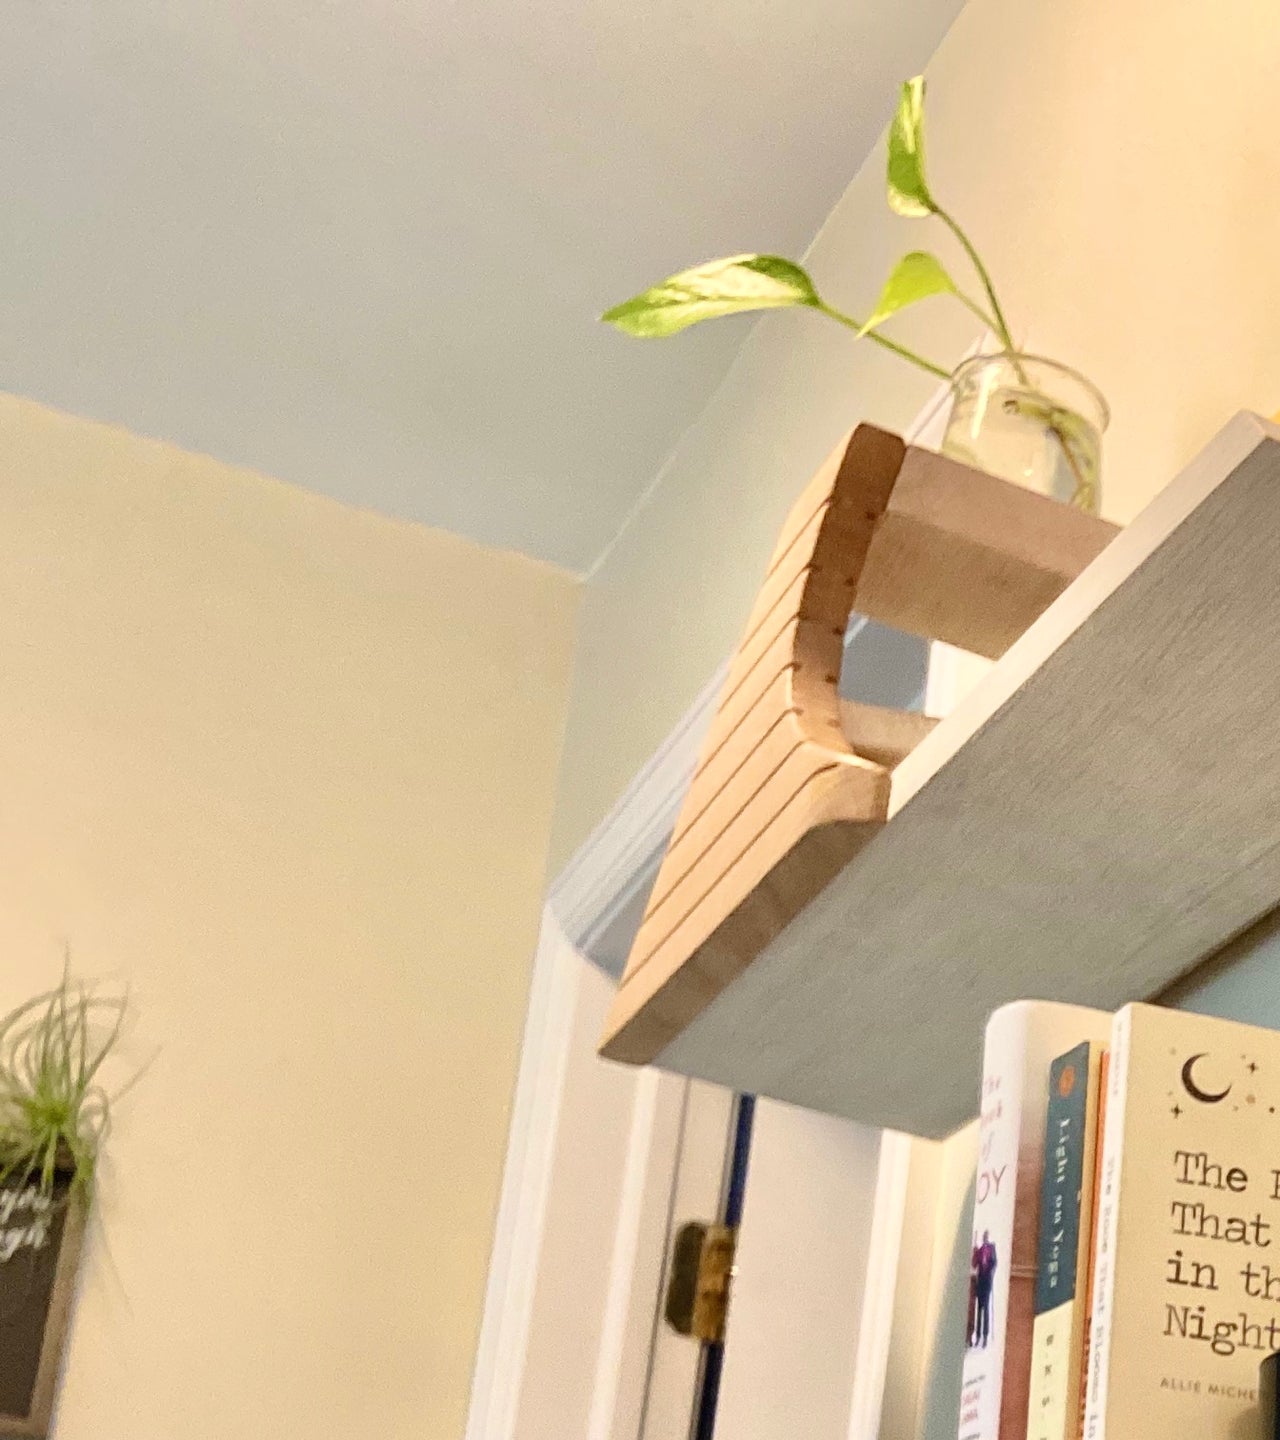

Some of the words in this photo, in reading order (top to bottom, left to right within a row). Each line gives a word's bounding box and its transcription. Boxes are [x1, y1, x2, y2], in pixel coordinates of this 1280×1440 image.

[1054, 1117, 1071, 1184] Light
[1173, 1149, 1249, 1193] The
[975, 1164, 1008, 1205] OY
[1053, 1193, 1064, 1225] on
[1100, 1205, 1113, 1255] Rose
[1170, 1200, 1272, 1248] That
[1047, 1228, 1065, 1290] Yoga
[1165, 1249, 1220, 1291] in
[1096, 1261, 1111, 1317] That
[1088, 1326, 1105, 1404] Blooms
[1159, 1376, 1202, 1394] ALLIE
[1088, 1412, 1100, 1440] in
